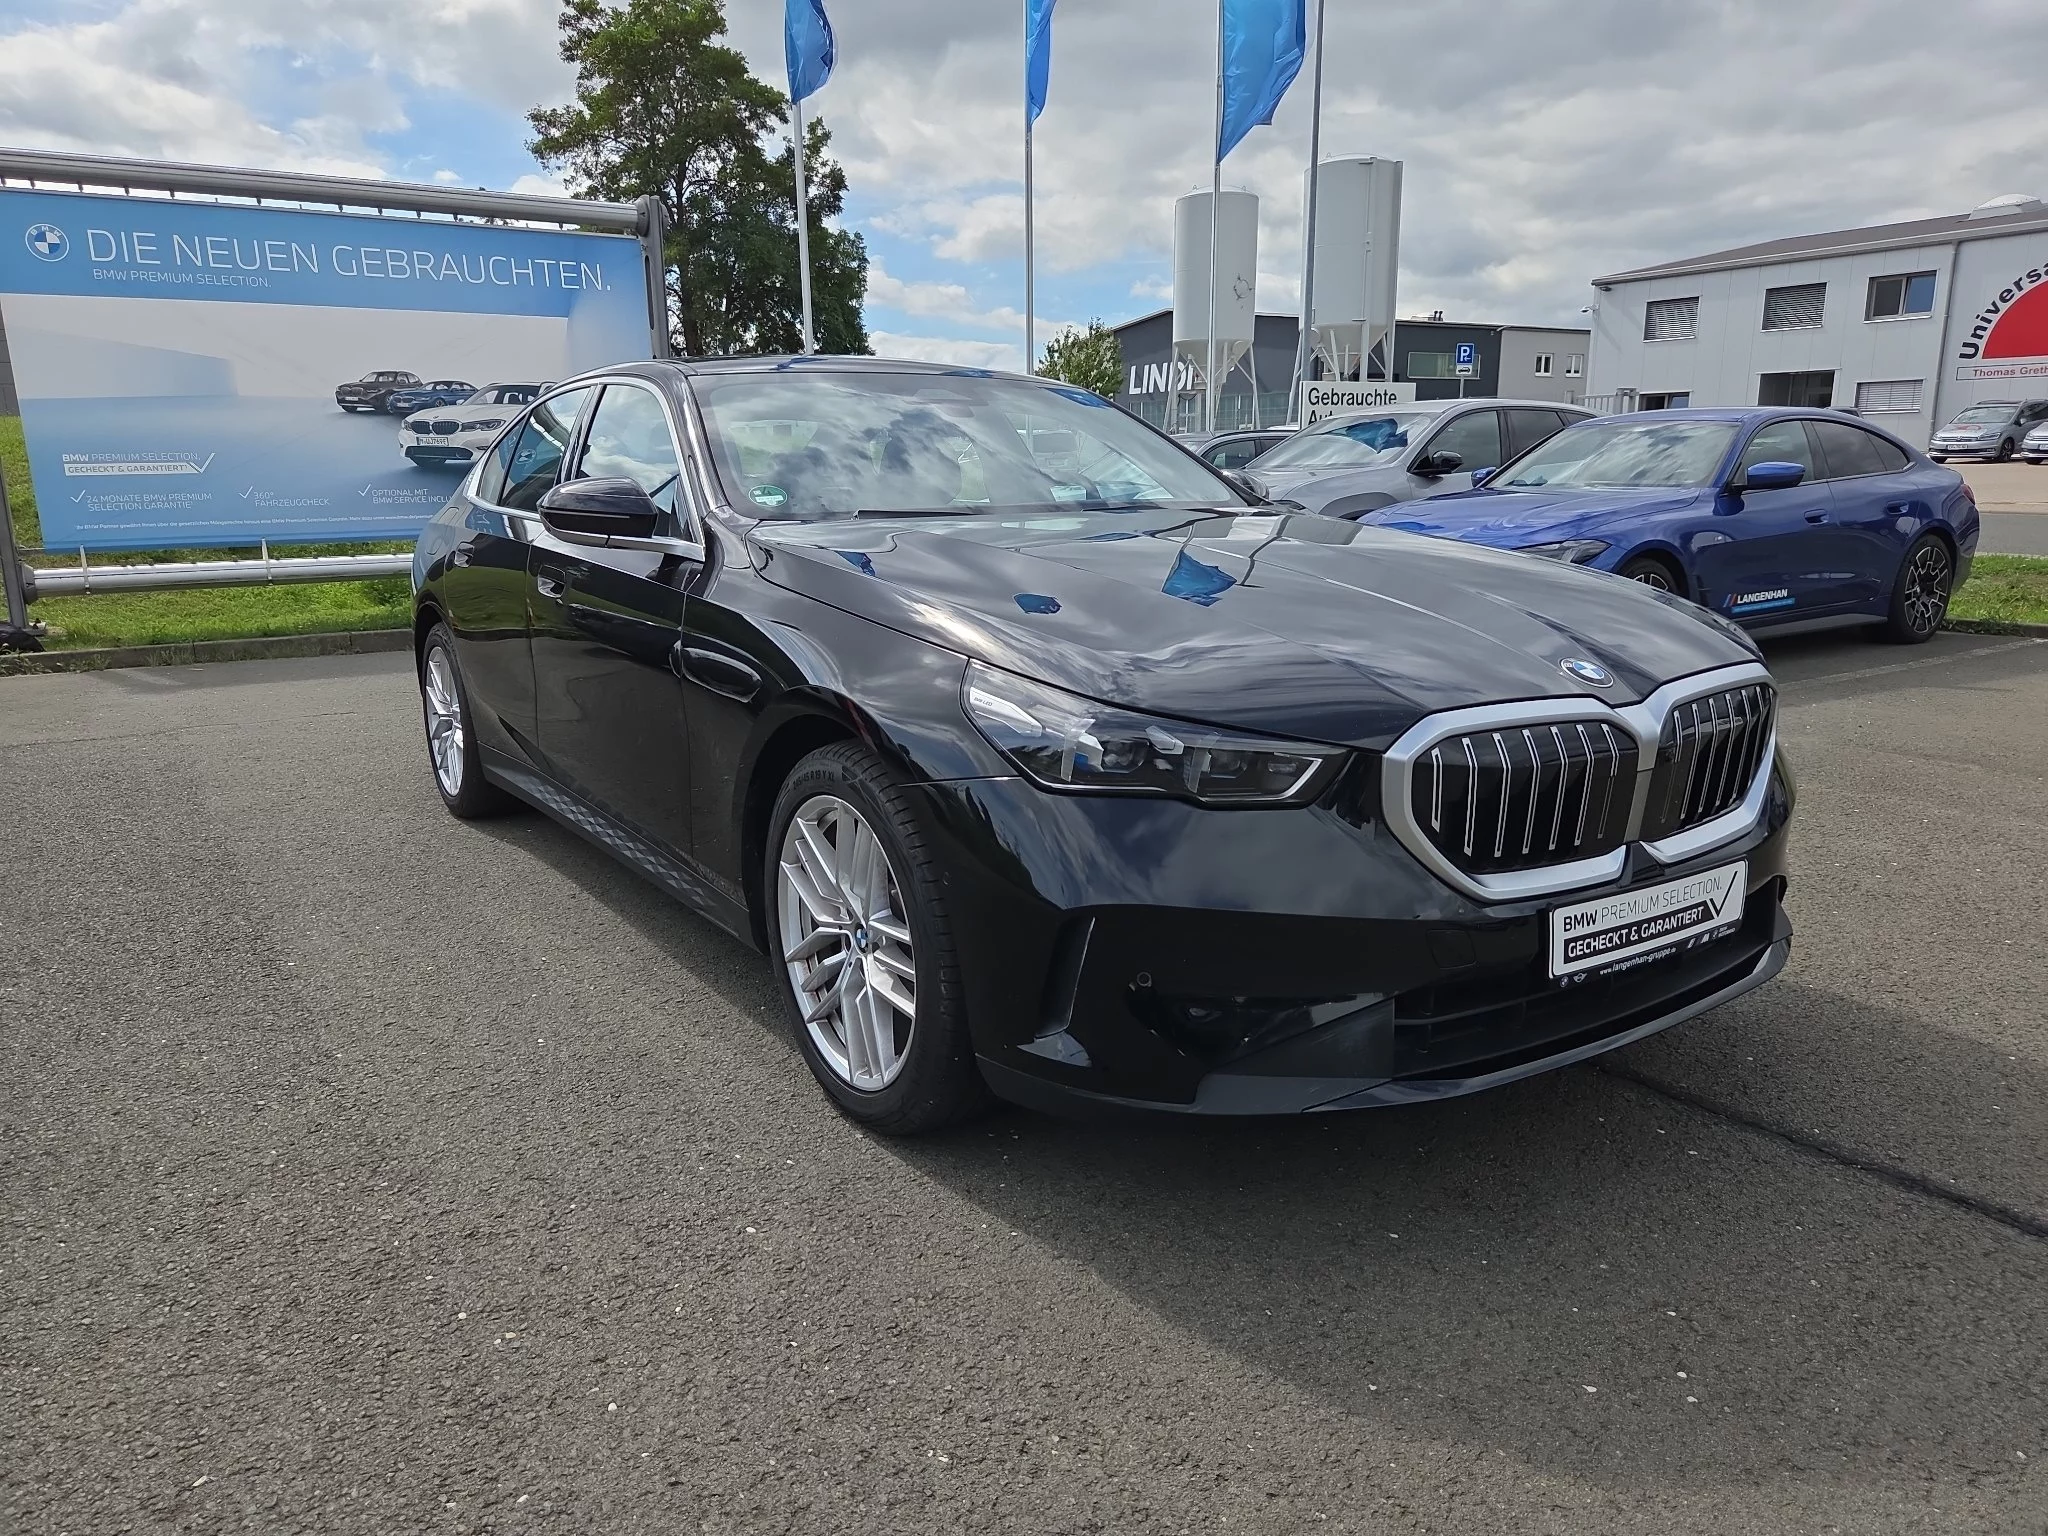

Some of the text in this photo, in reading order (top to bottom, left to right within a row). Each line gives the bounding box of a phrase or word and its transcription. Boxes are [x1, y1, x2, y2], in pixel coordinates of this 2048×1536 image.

[87, 229, 611, 291] DIE NEUEN GEBRAUCHTEN.
[93, 268, 272, 288] BMW PREMIUM SELECTION.
[1460, 346, 1470, 362] P
[1972, 369, 2016, 378] Thomas
[1308, 387, 1397, 406] Gebrauchte
[63, 454, 88, 462] BMW
[92, 453, 140, 461] PREMIUM
[68, 465, 116, 474] GECHECKT
[86, 493, 212, 503] 24 MONATE BMW PREMIUM
[371, 488, 428, 497] OPTIONAL MIT
[255, 498, 330, 507] FAHRZEUGCHECK
[373, 496, 392, 504] BMW
[395, 495, 427, 504] SERVICE
[88, 502, 142, 512] SELECTION
[1737, 588, 1788, 604] LANGENHAN
[1564, 878, 1722, 933] BMW PREMIUM SELECTION.
[1568, 929, 1628, 957] GECHECKT
[1630, 926, 1639, 941] &
[1641, 906, 1705, 938] GARANTIERT
[1599, 947, 1677, 975] www.langenhan-gruppe.de
